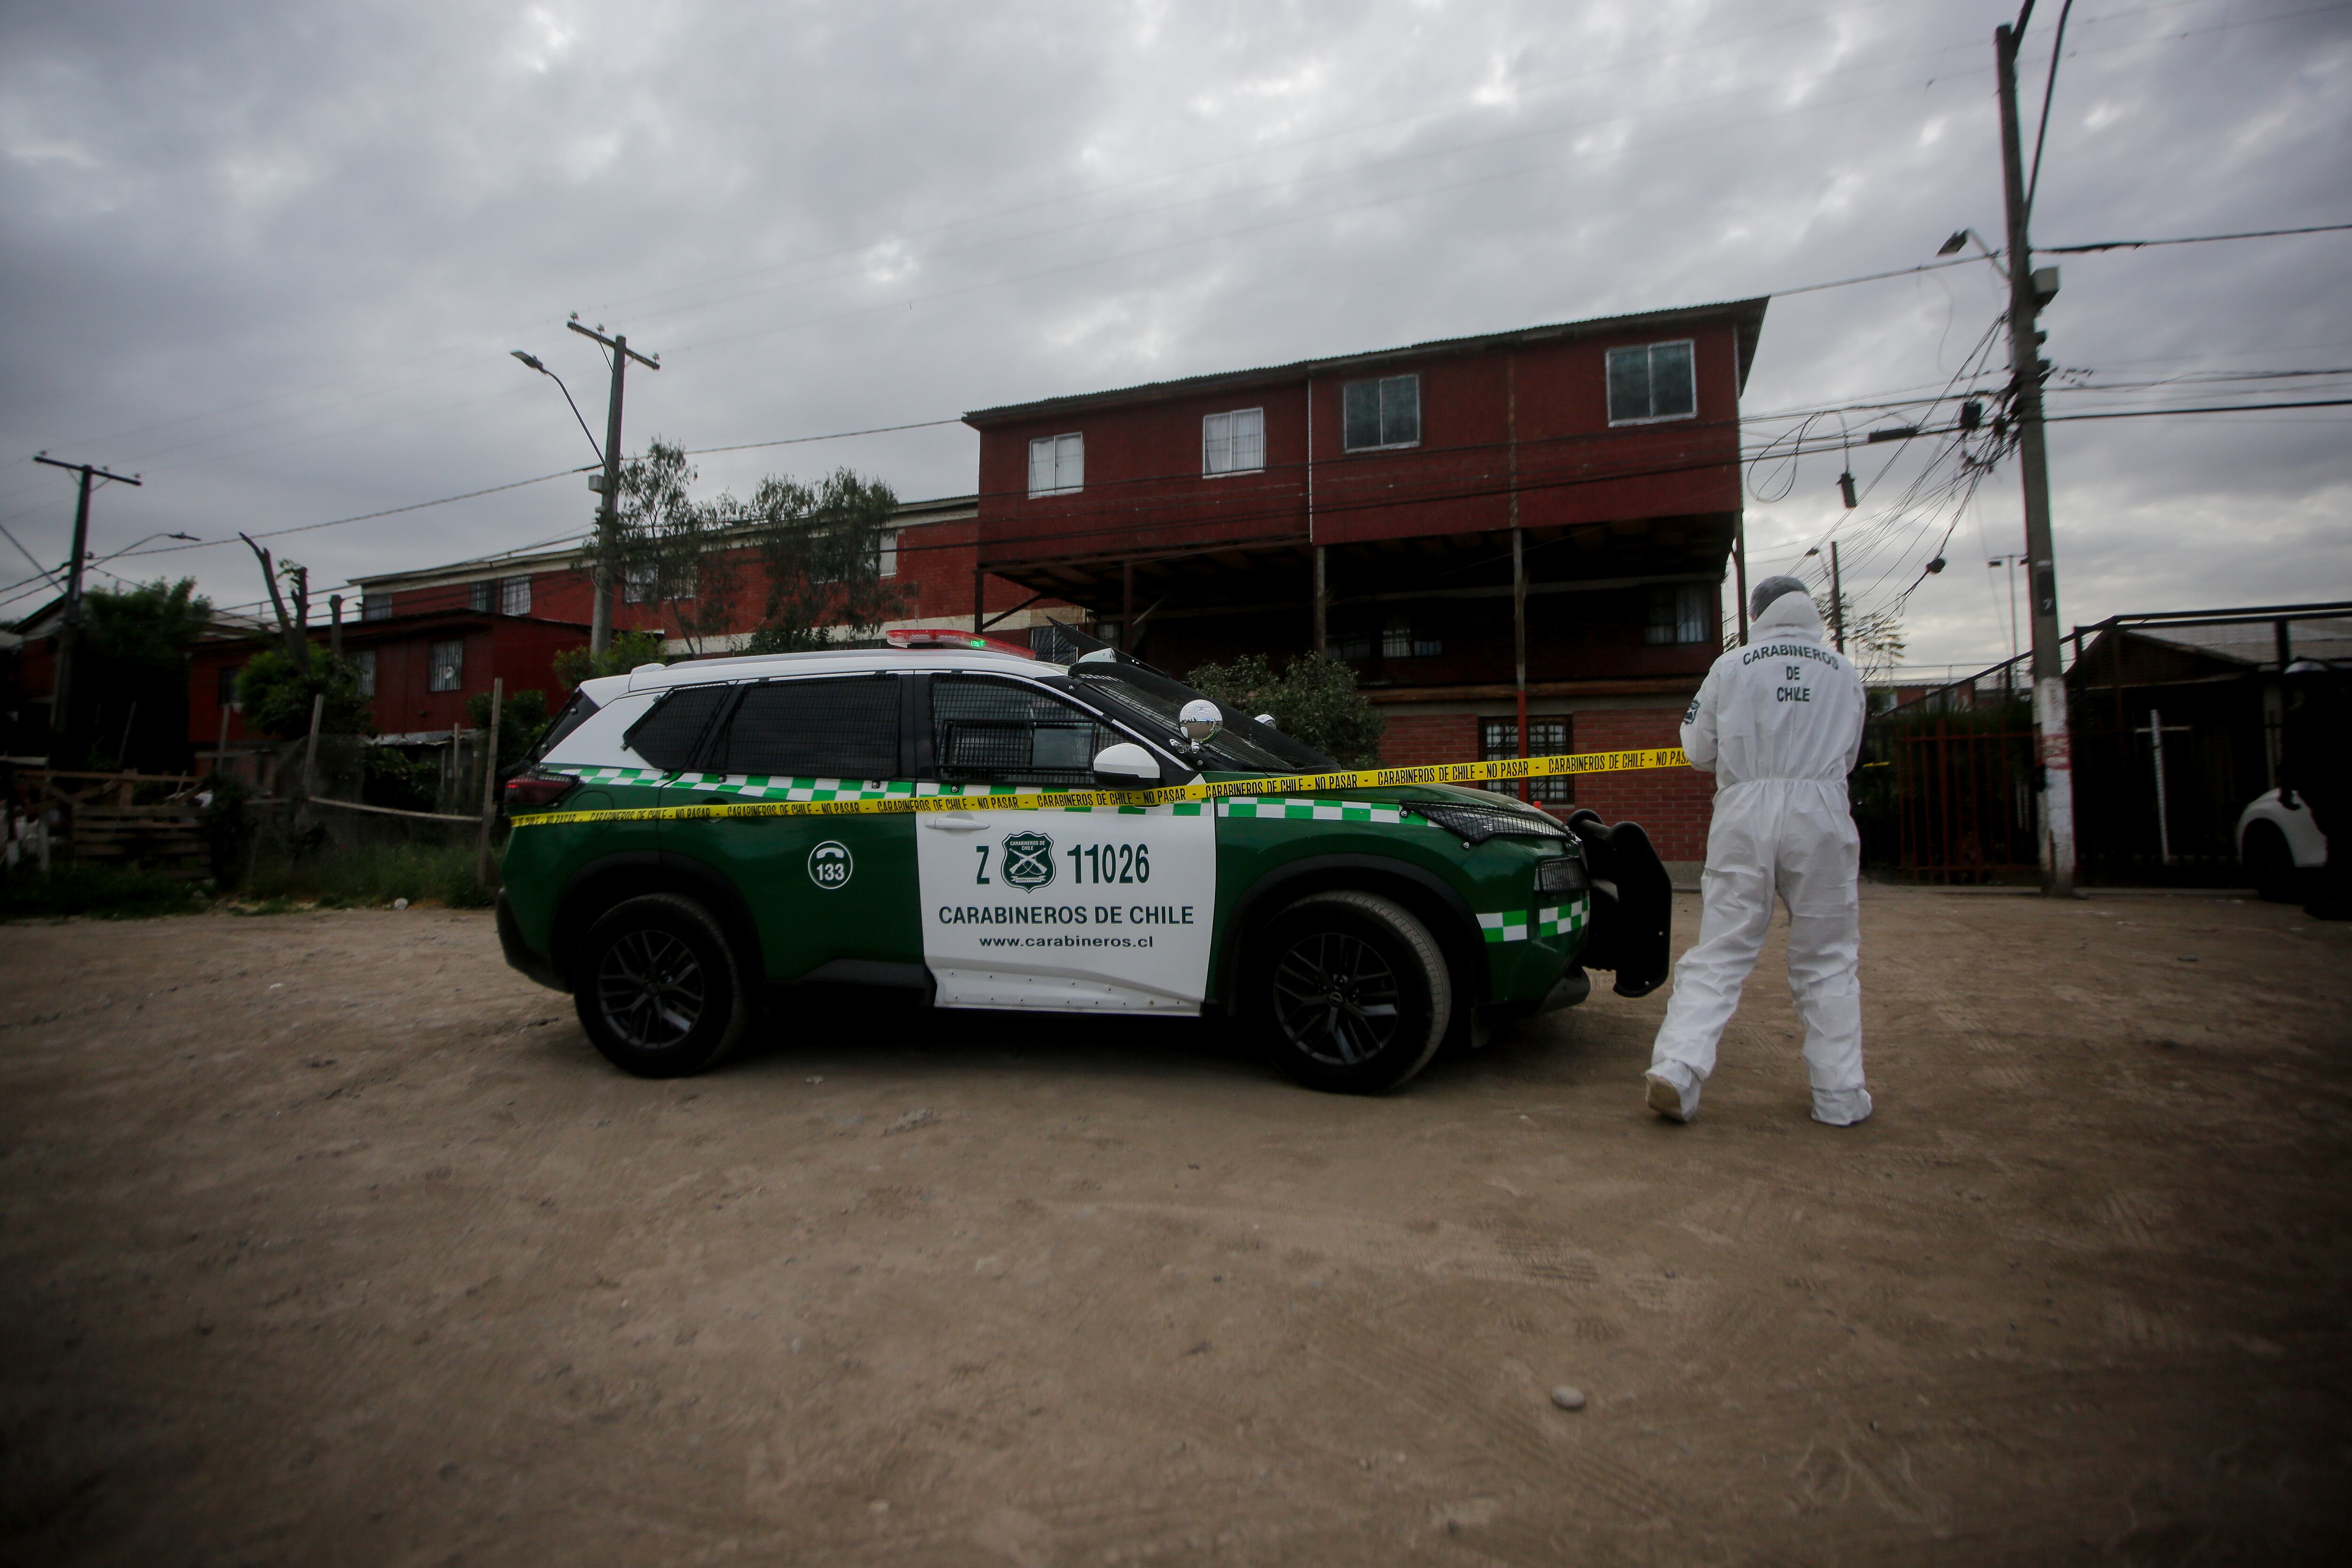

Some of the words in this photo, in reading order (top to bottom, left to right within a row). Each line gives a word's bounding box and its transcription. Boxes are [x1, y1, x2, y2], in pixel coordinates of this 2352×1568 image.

[1743, 645, 1839, 670] CARABINEROS
[1786, 666, 1800, 680] DE
[1777, 686, 1810, 702] CHILE
[791, 804, 811, 815] CHILE
[821, 803, 833, 814] NO
[834, 802, 861, 814] PASAR
[877, 800, 930, 813] CARABINEROS
[933, 799, 945, 811] DE
[946, 798, 968, 811] CHILE
[977, 797, 989, 809] NO
[992, 796, 1019, 809] PASAR
[1037, 794, 1093, 807] CARABINEROS
[1096, 793, 1107, 805] DE
[1110, 791, 1133, 804] CHILE
[1143, 790, 1155, 804] NO
[1157, 788, 1186, 803] PASAR
[1206, 781, 1263, 798] CARABINEROS
[1267, 780, 1277, 793] DE
[1280, 778, 1303, 792] CHILE
[1314, 776, 1326, 790] NO
[1329, 774, 1357, 789] PASAR
[1378, 767, 1435, 786] CARABINEROS
[1439, 766, 1449, 781] DE
[1452, 764, 1475, 780] CHILE
[1486, 763, 1497, 778] NO
[1501, 761, 1528, 777] PASAR
[1549, 755, 1605, 773] CARABINEROS
[1608, 754, 1619, 769] DE
[1622, 752, 1645, 768] CHILE
[1656, 751, 1667, 766] NO
[1669, 750, 1689, 765] PAS
[817, 864, 844, 881] 133
[976, 845, 990, 885] Z
[1067, 844, 1150, 884] 11026
[938, 906, 1088, 925] CARABINEROS
[1095, 906, 1122, 924] DE
[1129, 906, 1194, 925] CHILE
[978, 935, 1153, 947] www.carabineros.cl
